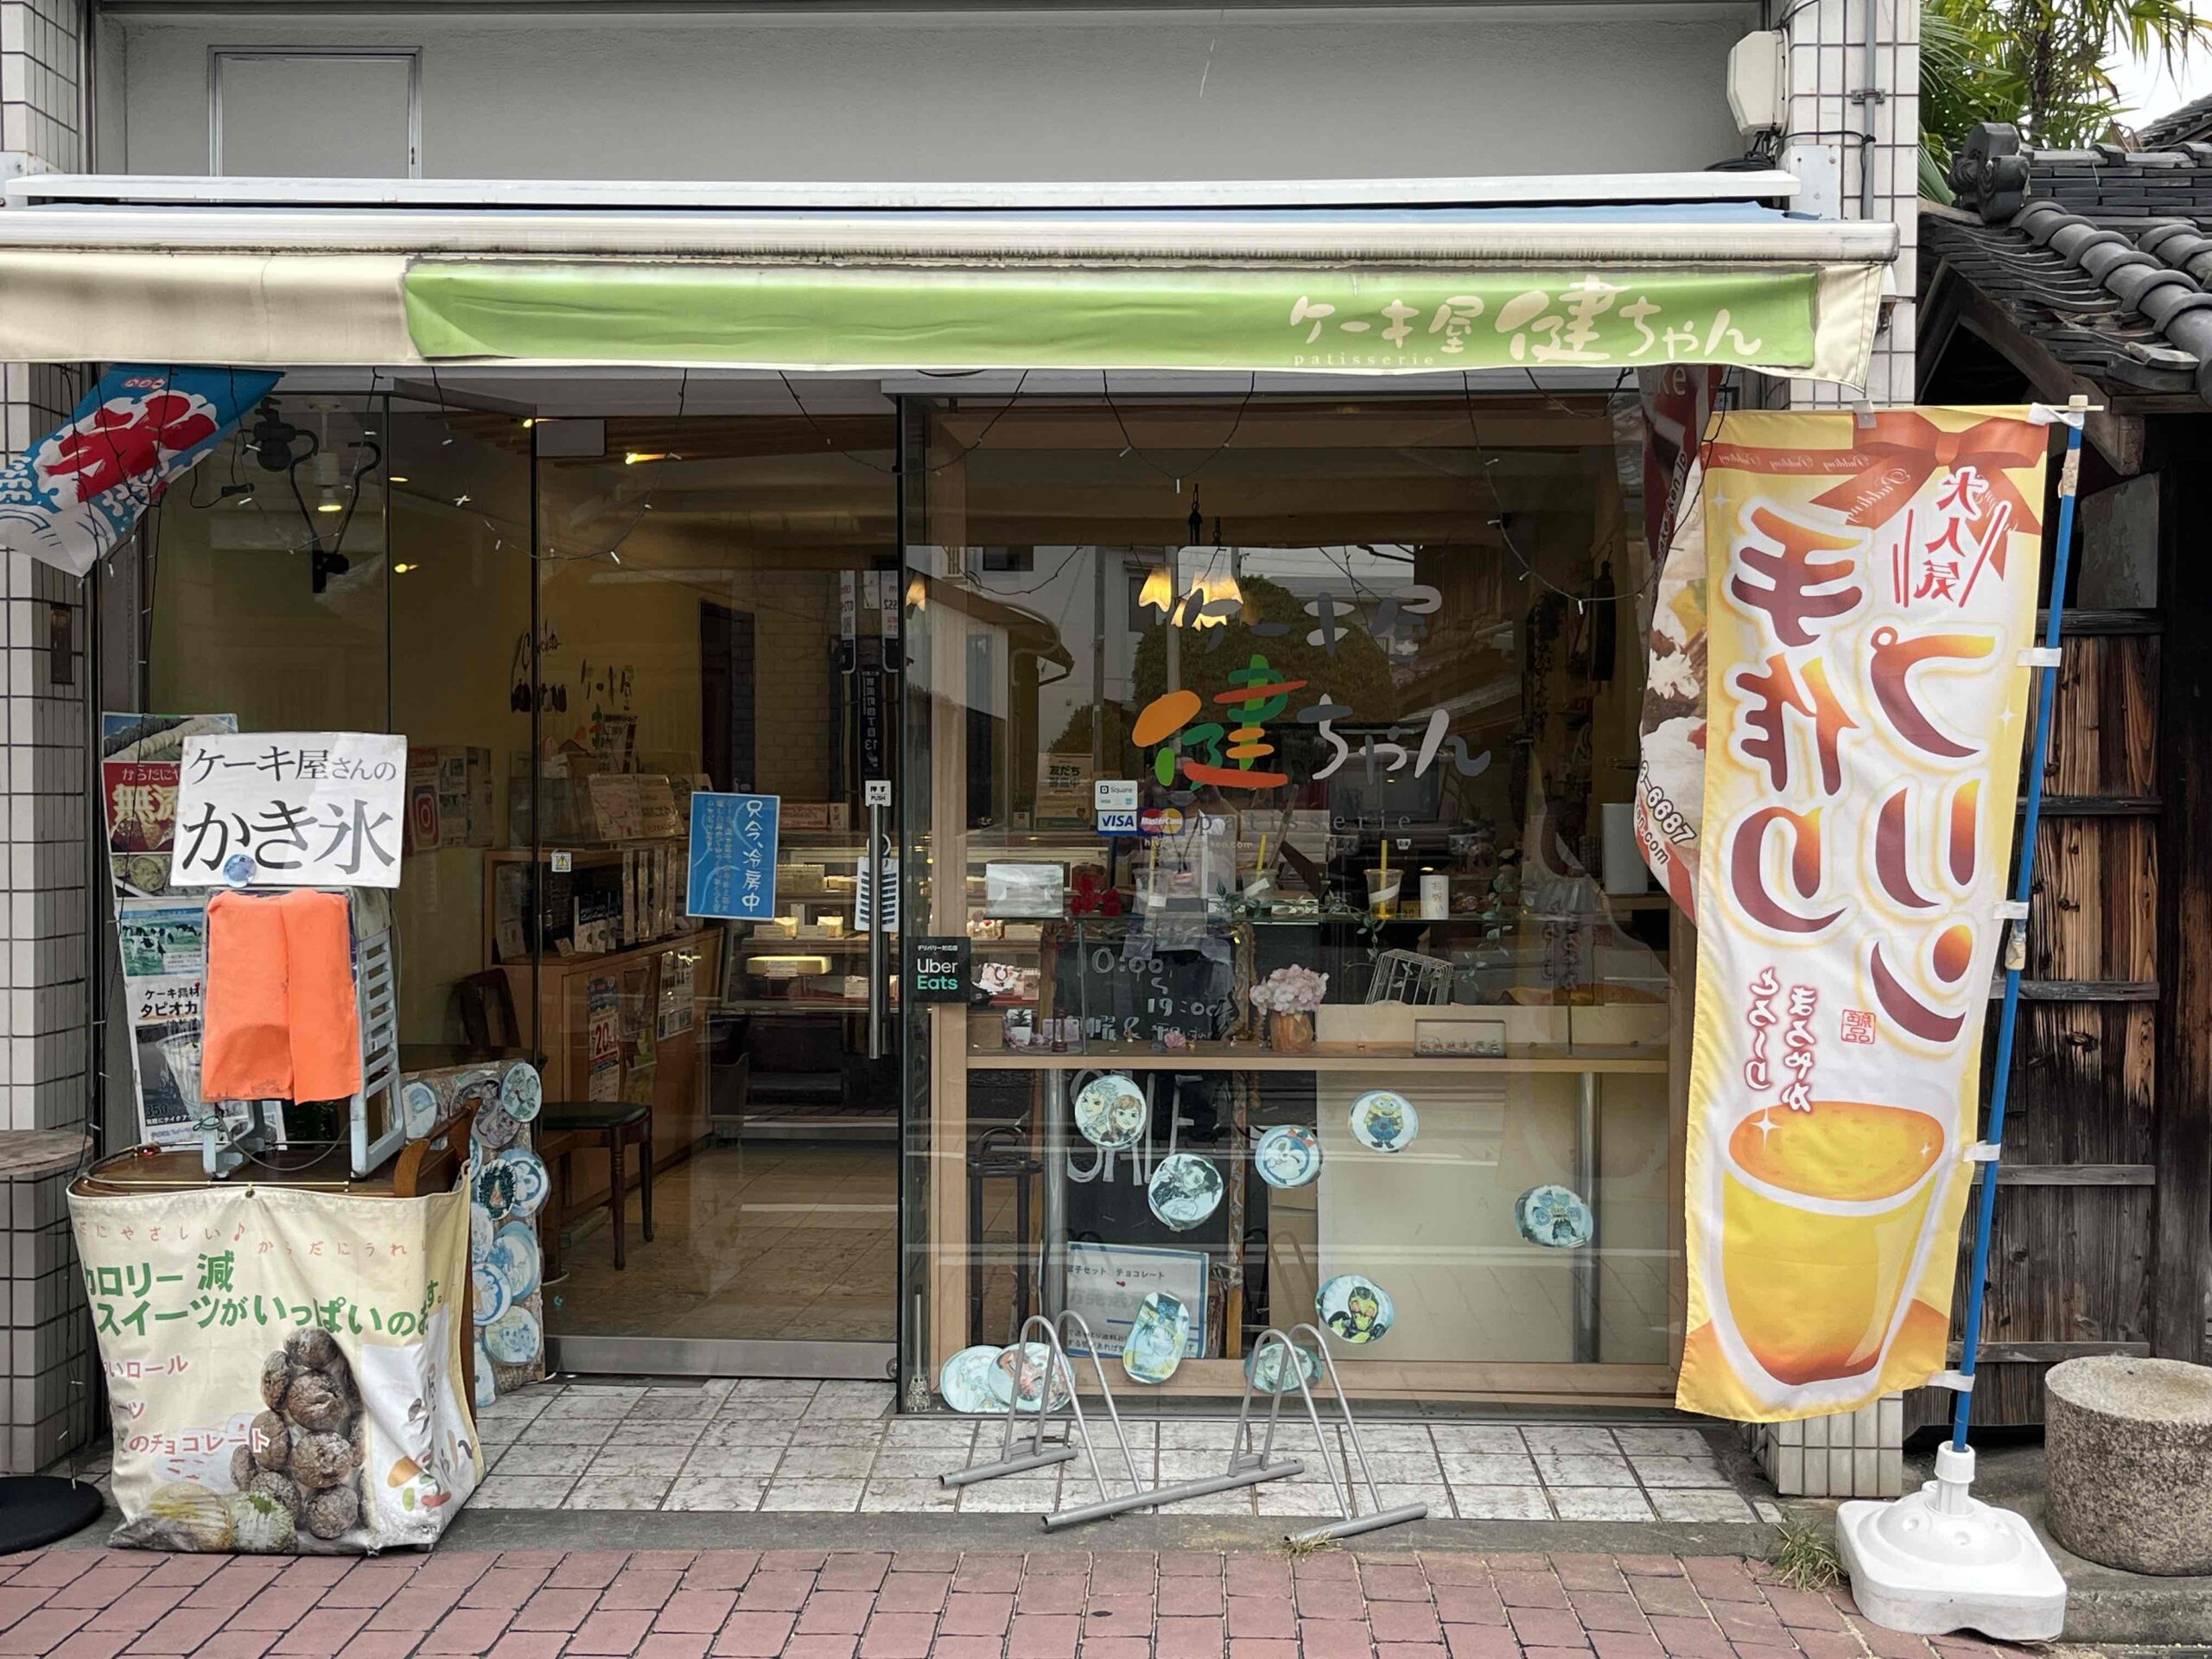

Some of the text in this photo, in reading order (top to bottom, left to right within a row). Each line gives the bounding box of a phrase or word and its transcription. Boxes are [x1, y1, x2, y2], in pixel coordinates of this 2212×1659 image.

[1290, 274, 1763, 361] ケーキ屋 健ちゃん
[1294, 353, 1435, 366] patisserie
[1132, 654, 1491, 791] 健ちゃん
[188, 745, 397, 785] ケーキ屋さんの
[1049, 765, 1080, 776] 友だち
[1102, 815, 1135, 827] VISA
[181, 798, 397, 875] かき氷
[741, 799, 765, 913] 只今、冷房中
[917, 957, 958, 974] Uber
[917, 975, 958, 990] Eats
[140, 1001, 198, 1018] タピオカ
[196, 1249, 235, 1294] 減
[1116, 1268, 1165, 1280] チョコレート
[121, 1427, 271, 1455] のチョコレート
